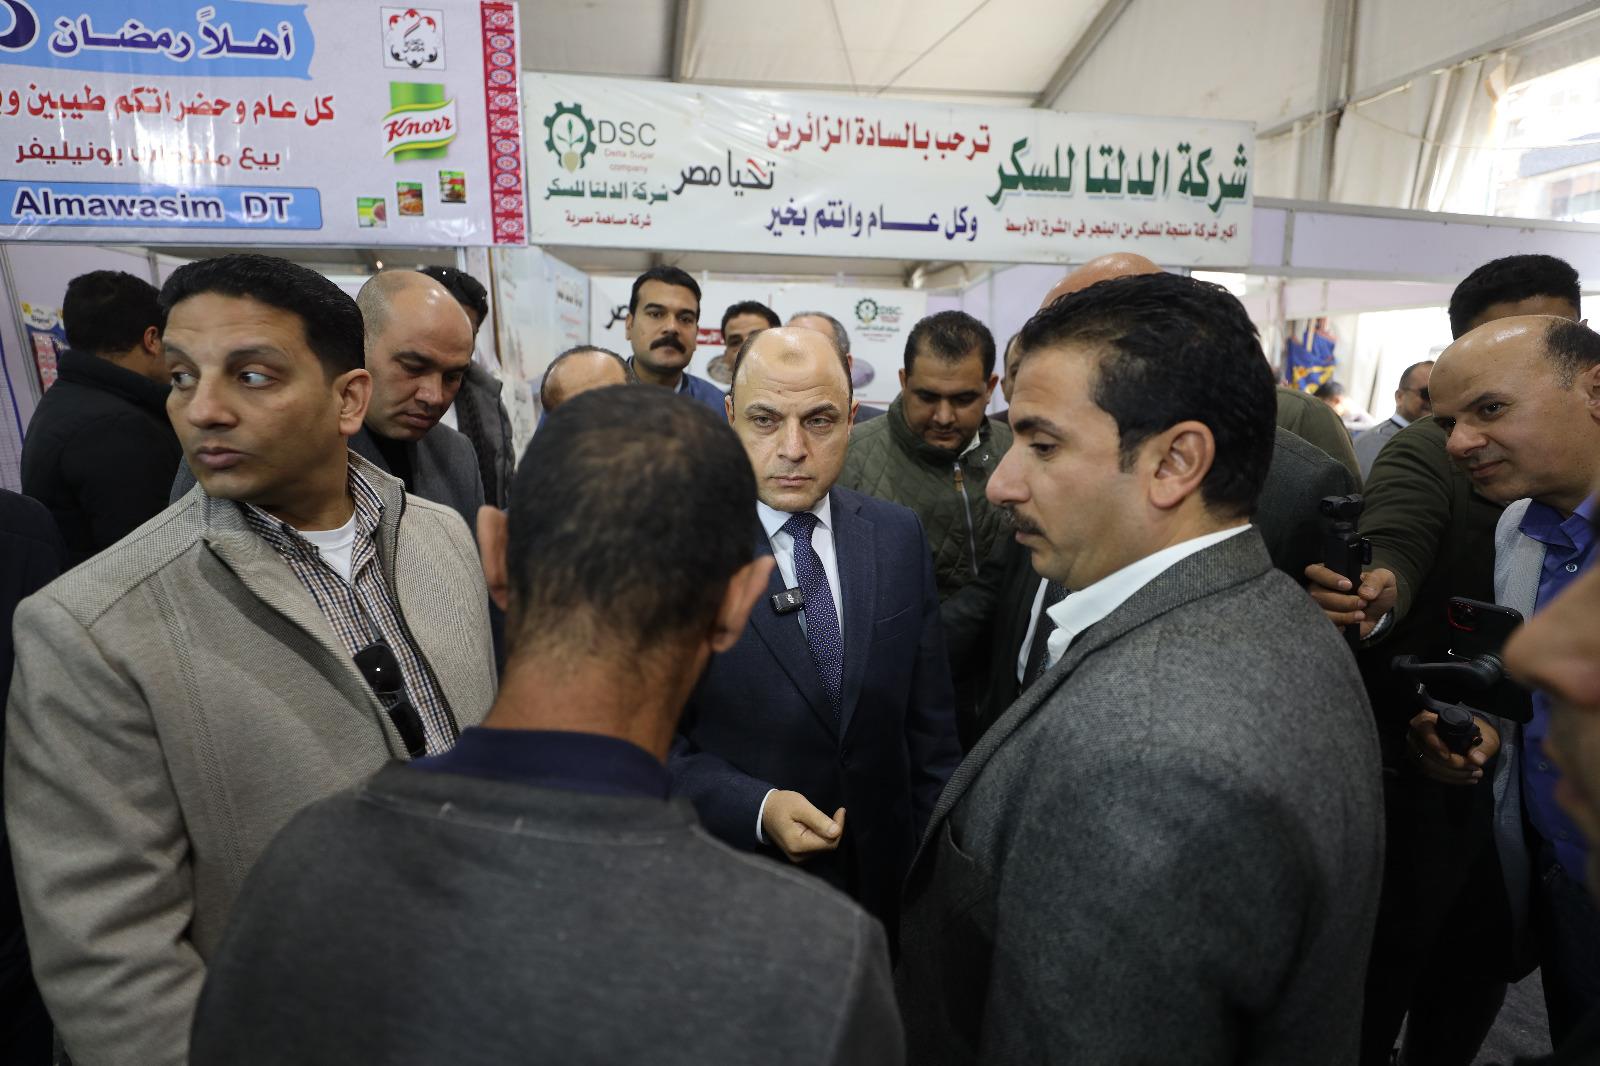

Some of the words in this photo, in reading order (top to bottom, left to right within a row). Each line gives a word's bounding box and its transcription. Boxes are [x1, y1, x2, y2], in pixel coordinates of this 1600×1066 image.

[52, 18, 192, 58] رمضان
[27, 83, 106, 120] طيبين
[253, 93, 297, 125] عام
[304, 94, 334, 126] كل
[383, 115, 453, 143] Knorr
[598, 120, 656, 147] DSC
[767, 112, 850, 153] الزائرين
[855, 116, 930, 161] بالسادة
[934, 124, 991, 161] ترحب
[239, 147, 280, 170] بيع
[604, 149, 627, 158] Delta
[671, 165, 722, 196] مصر
[727, 149, 776, 197] تحيا
[986, 137, 1076, 206] للسكر
[1086, 144, 1170, 197] الدلتا
[1177, 141, 1249, 214] شركة
[15, 190, 222, 219] Almawasim
[244, 195, 290, 221] DT
[545, 177, 586, 201] للسكر
[589, 180, 628, 200] الدلتا
[632, 181, 668, 206] شركة
[629, 212, 652, 229] شركة
[765, 196, 808, 237] بخير
[867, 203, 940, 238] عام
[945, 206, 978, 242] وكل
